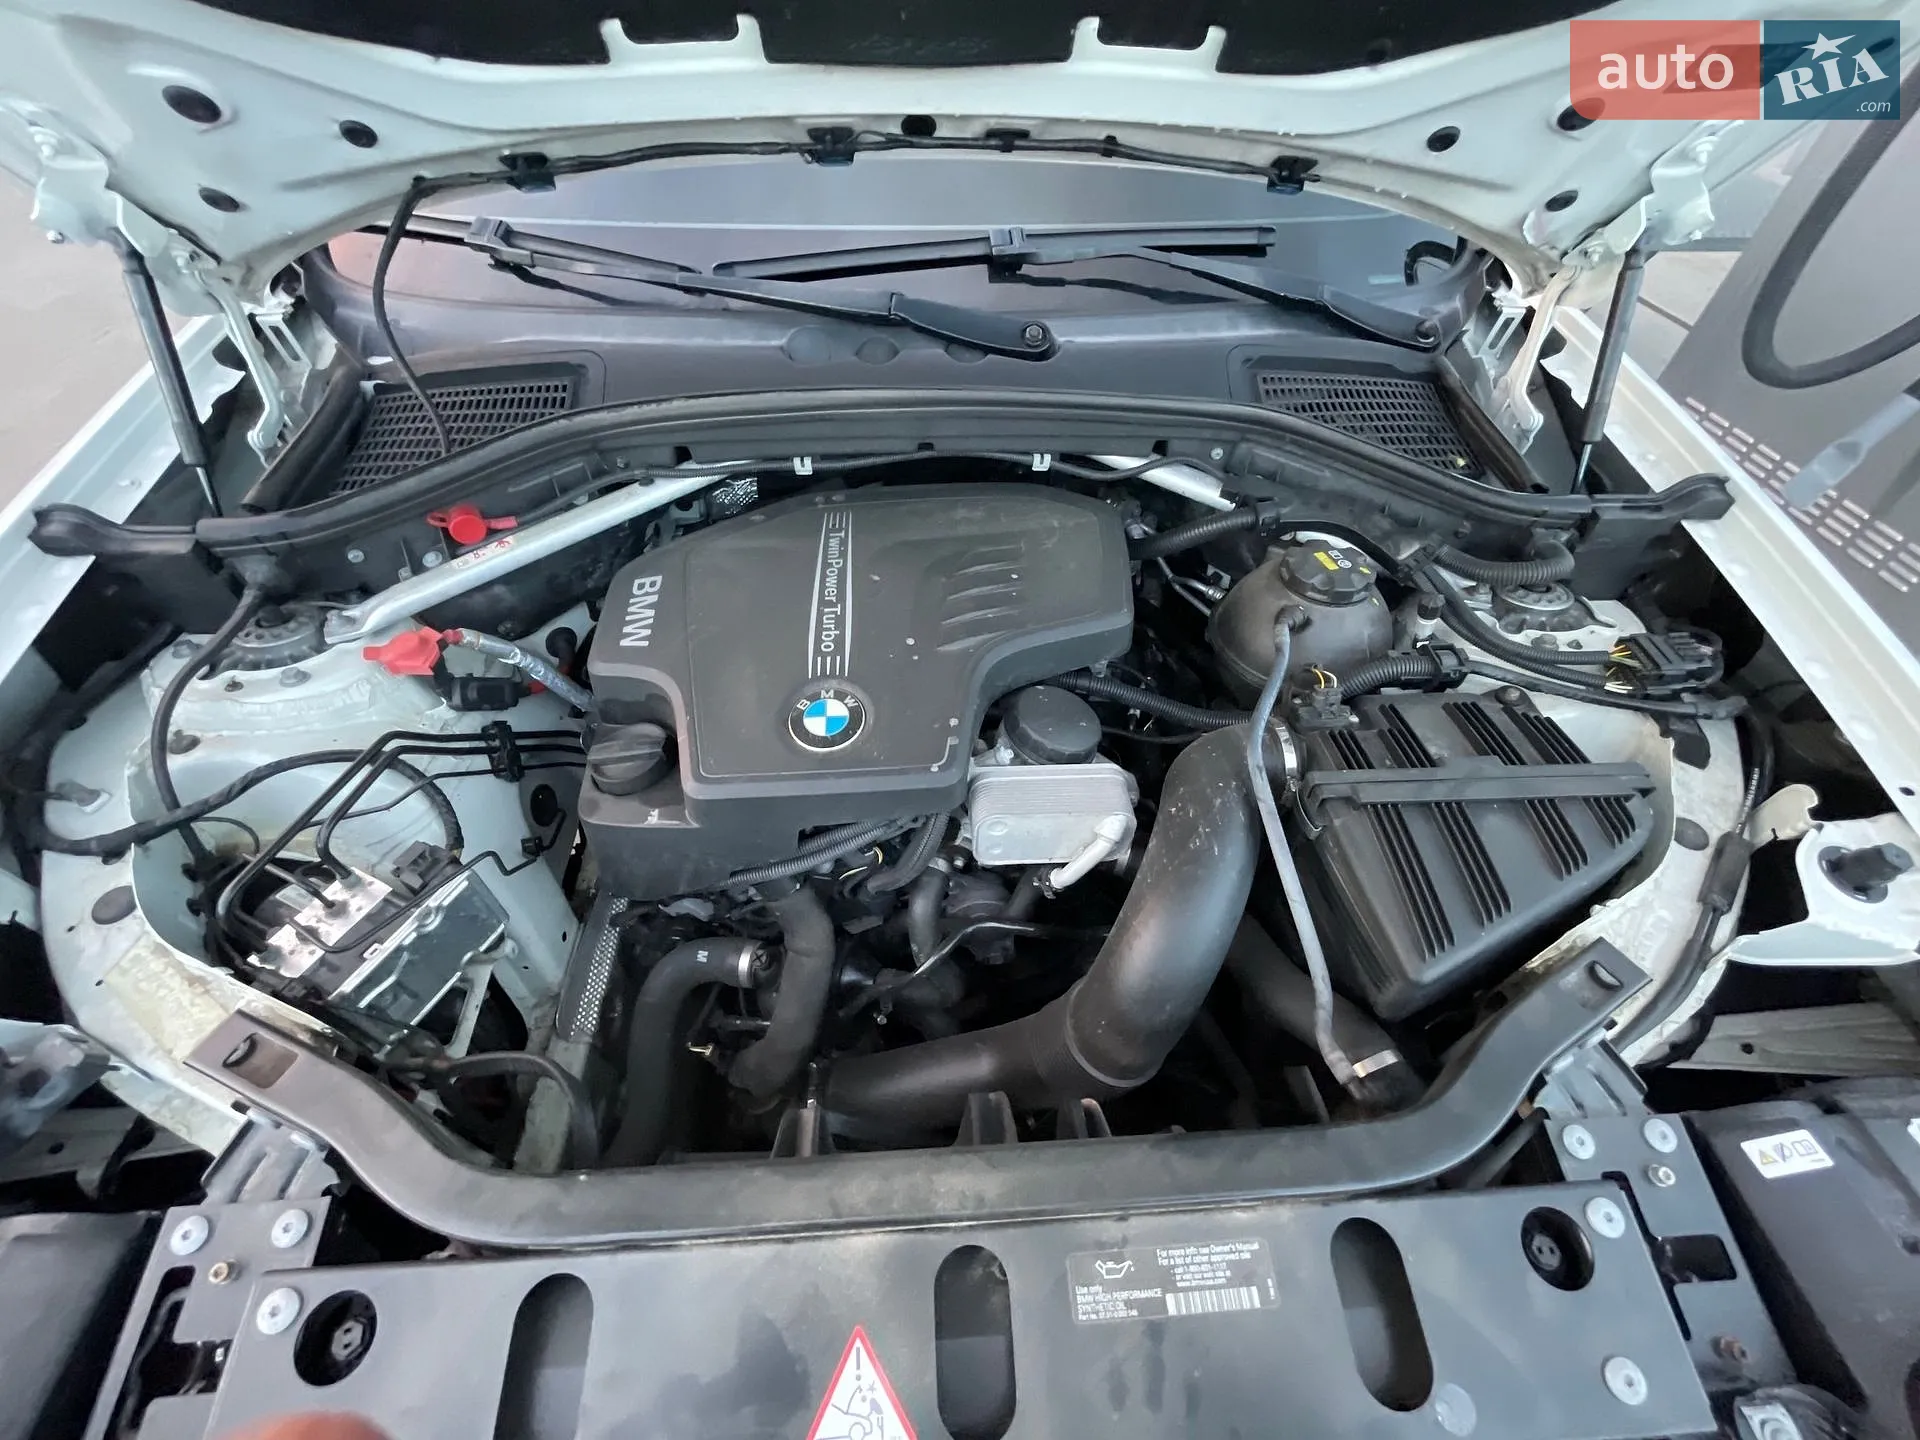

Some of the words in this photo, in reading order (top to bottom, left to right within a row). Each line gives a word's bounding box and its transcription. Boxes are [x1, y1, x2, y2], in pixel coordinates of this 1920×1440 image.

[824, 530, 845, 603] TwinPower
[619, 575, 663, 647] BMW
[820, 604, 841, 652] Turbo
[796, 689, 858, 710] BMW
[1077, 1294, 1094, 1304] BMW
[1112, 1287, 1162, 1300] PERFORMANCE
[1115, 1301, 1127, 1310] OIL
